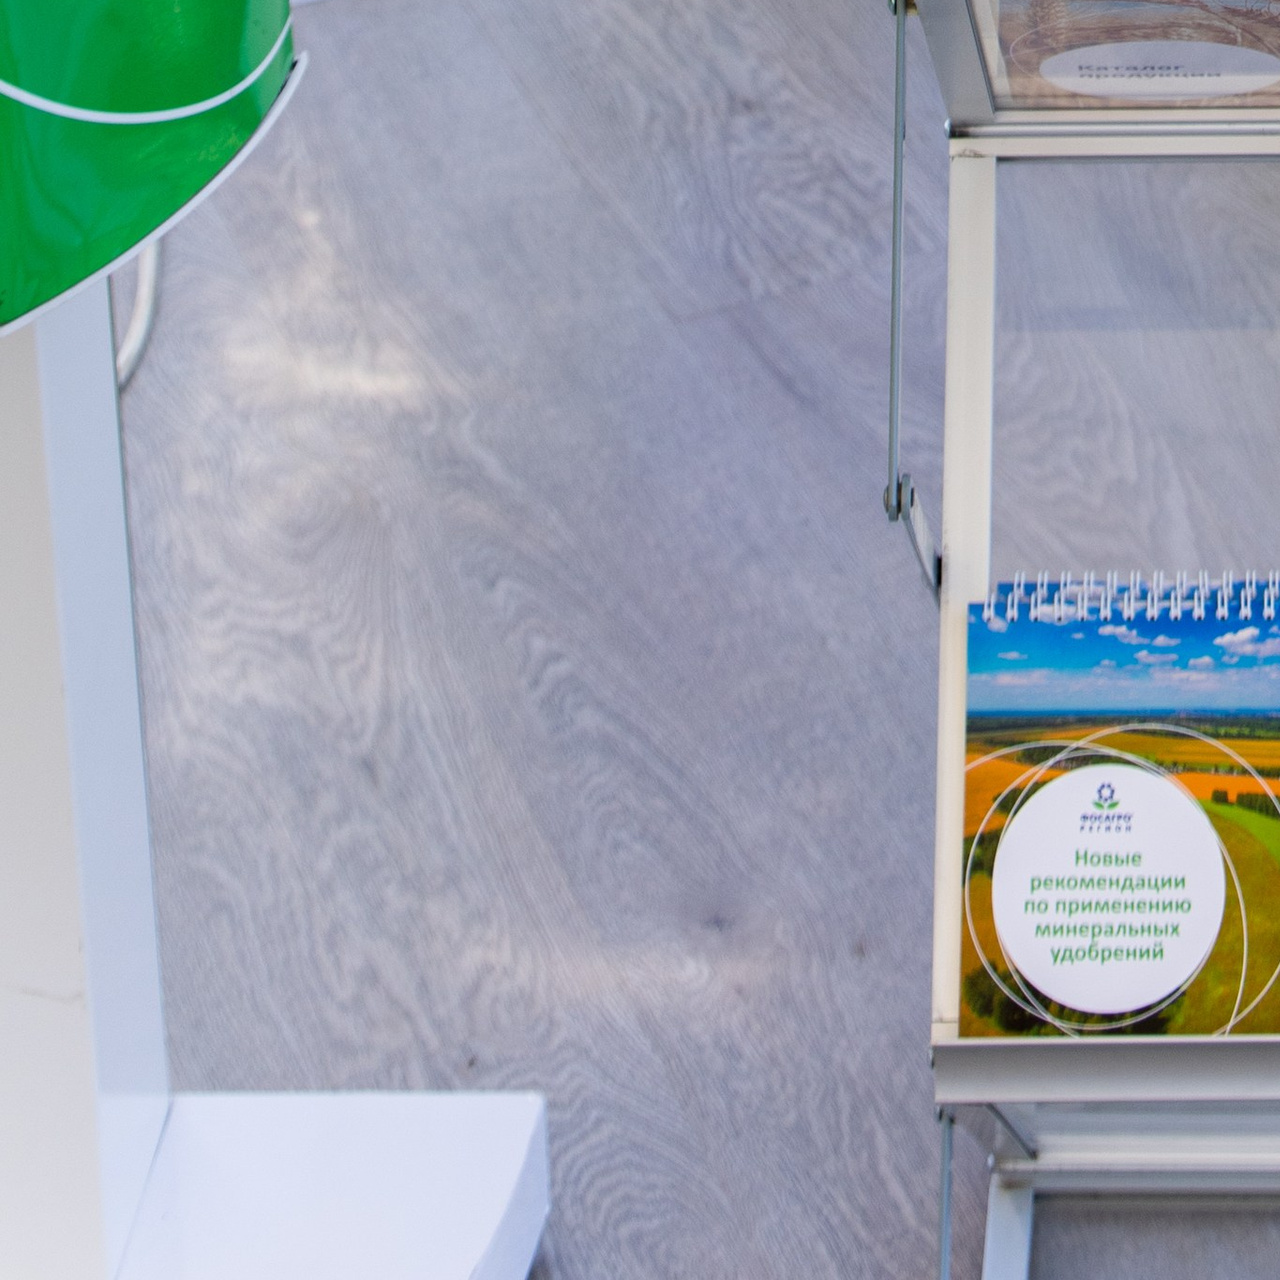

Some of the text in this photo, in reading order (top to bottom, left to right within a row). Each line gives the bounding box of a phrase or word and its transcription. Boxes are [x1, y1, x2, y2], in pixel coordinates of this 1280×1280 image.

[1074, 849, 1142, 867] Новые
[1030, 876, 1187, 894] рекомендации
[1024, 899, 1192, 917] по применению
[1035, 923, 1181, 941] минеральных
[1051, 942, 1165, 966] удобрений
